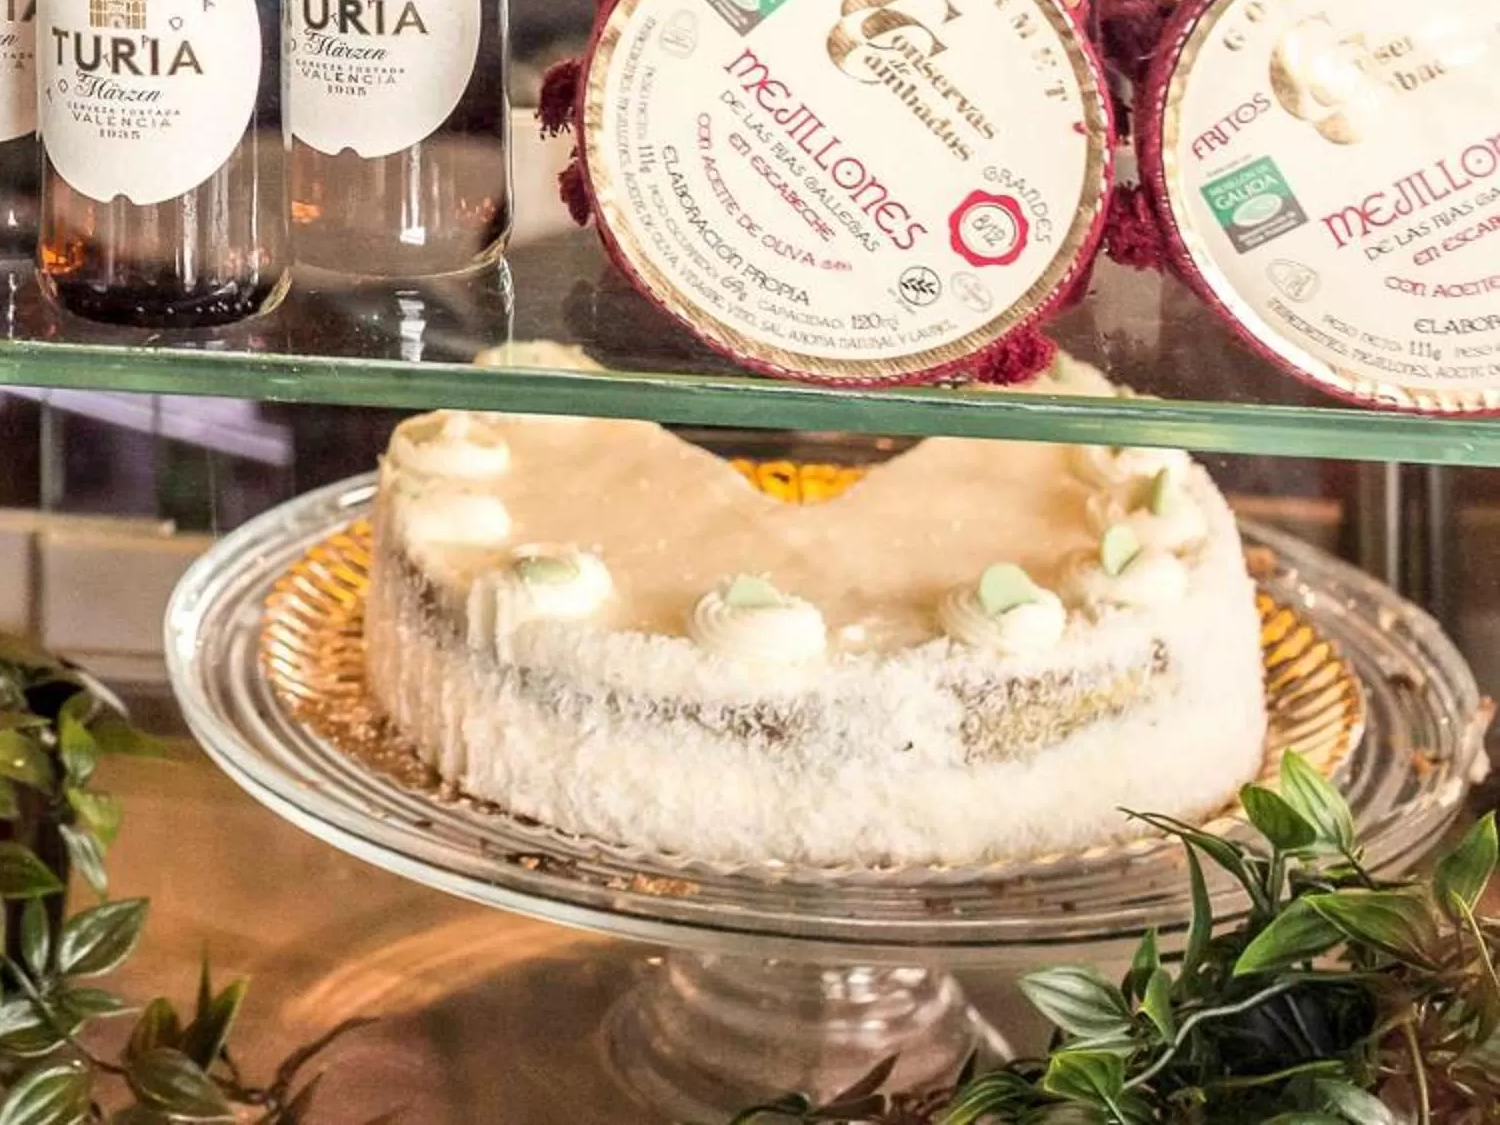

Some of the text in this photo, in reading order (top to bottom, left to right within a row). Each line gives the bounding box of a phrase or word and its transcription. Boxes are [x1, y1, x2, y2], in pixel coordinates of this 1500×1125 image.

[52, 25, 205, 78] TURIA
[302, 27, 388, 61] Märzen
[74, 68, 164, 103] Märzen
[300, 67, 398, 86] VALENCIA
[71, 110, 174, 130] VALENCIA
[723, 48, 929, 251] MEJILLONES
[1191, 91, 1271, 161] FRITOS
[719, 89, 746, 116] DE
[743, 112, 775, 144] LAS
[803, 175, 882, 253] GALLEGAS
[750, 154, 837, 243] ESCABECHE
[1320, 132, 1500, 250] MEJILLO
[701, 155, 741, 217] ACEITE
[737, 214, 763, 238] DE
[761, 233, 816, 267] OLIVA
[982, 165, 1053, 243] GRANDES
[1363, 239, 1394, 262] DE
[1394, 223, 1431, 248] LAS
[740, 263, 810, 307] PROPIA
